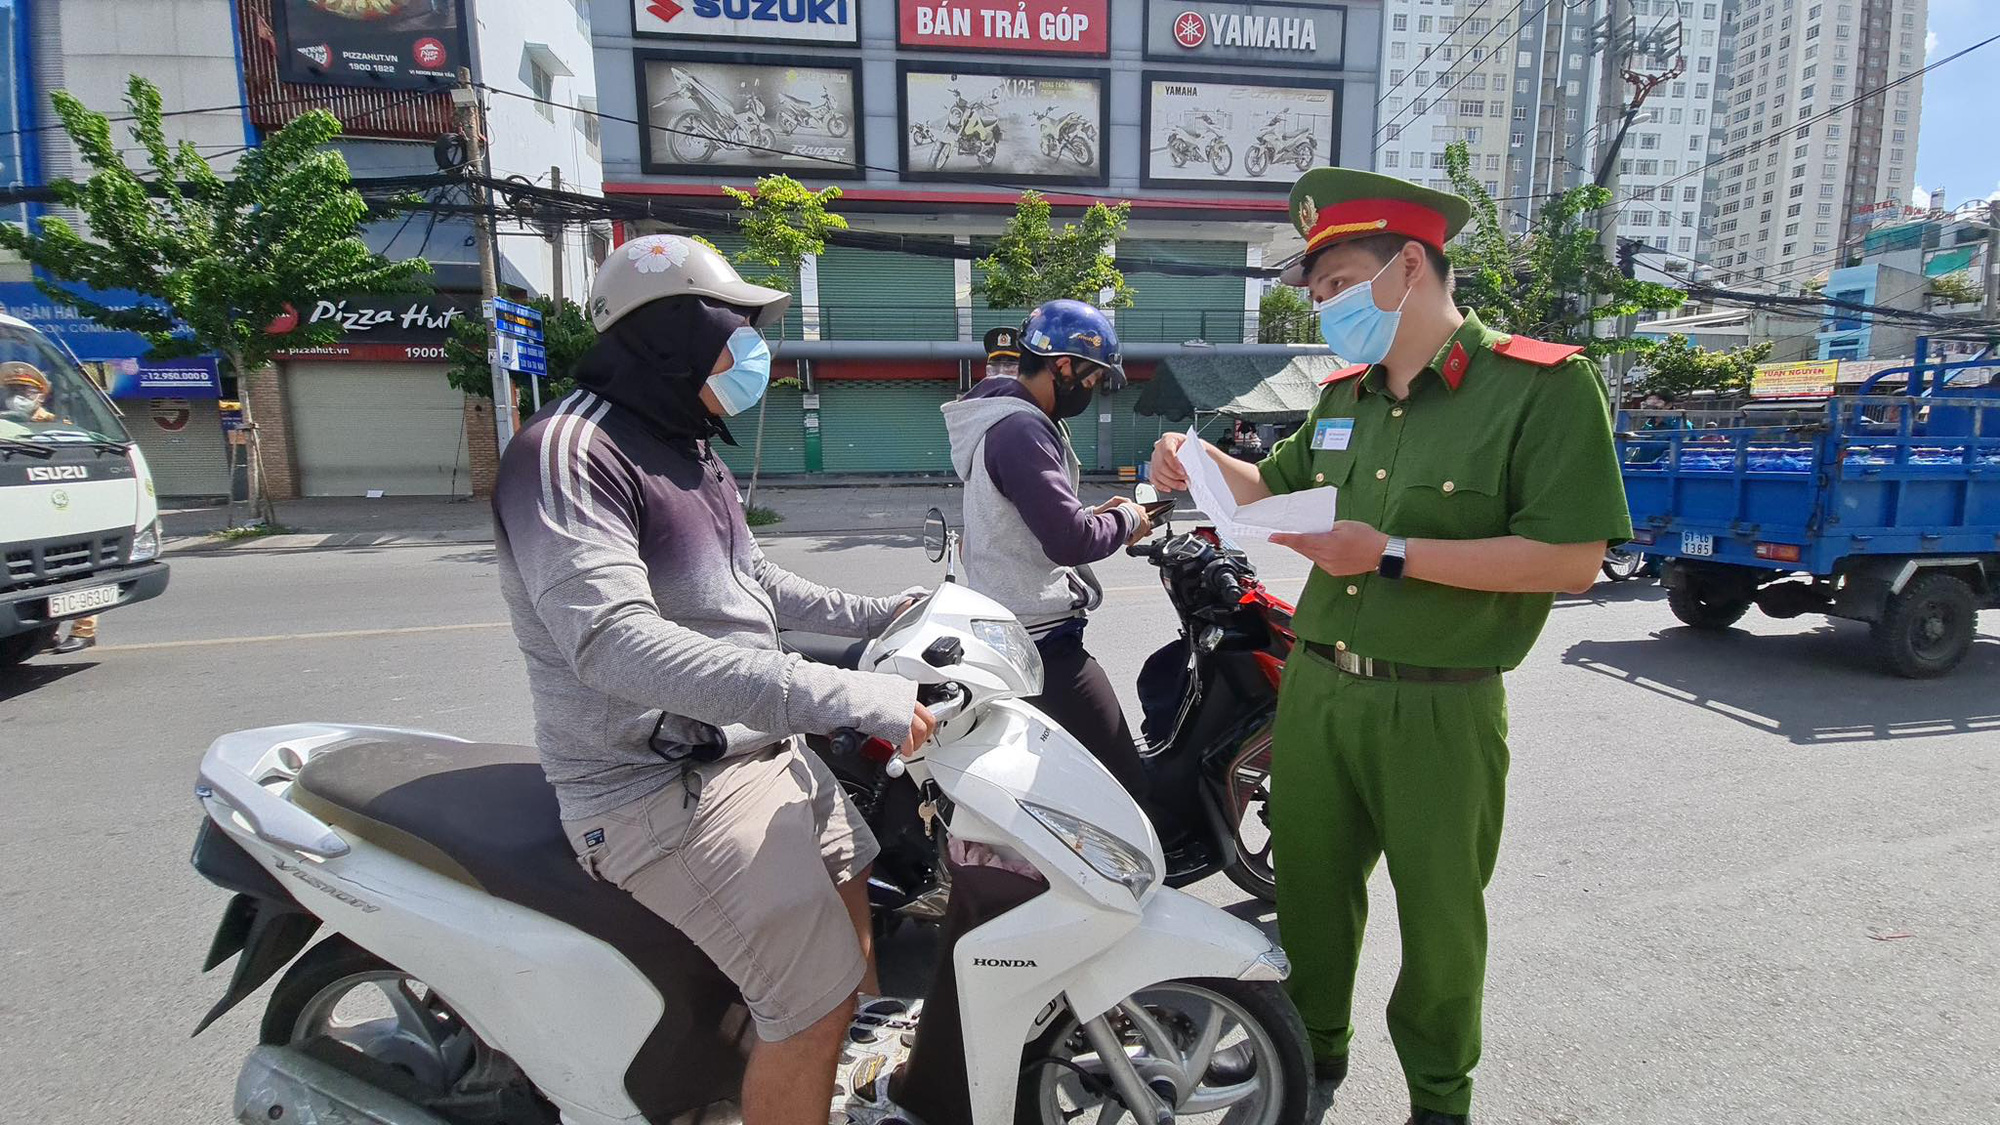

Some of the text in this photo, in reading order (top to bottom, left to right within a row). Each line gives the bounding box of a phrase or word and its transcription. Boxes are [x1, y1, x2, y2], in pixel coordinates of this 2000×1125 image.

[693, 0, 847, 25] SUZUKI
[917, 1, 1089, 42] BÁN TRẢ GÓP
[1209, 13, 1317, 50] YAMAHA
[342, 51, 398, 62] PIZZAHUT.VN
[349, 62, 395, 73] 1900 1822
[1164, 85, 1197, 97] YAMAHA
[791, 144, 846, 157] RAIDER
[309, 300, 394, 331] Pizza
[400, 303, 464, 329] Hut
[289, 345, 349, 356] pizzahut.vn
[405, 347, 449, 358] 19001
[148, 372, 199, 380] 12.950.000
[27, 466, 88, 481] ISUZU
[1685, 543, 1709, 554] 1385
[973, 957, 1038, 968] HONDA
